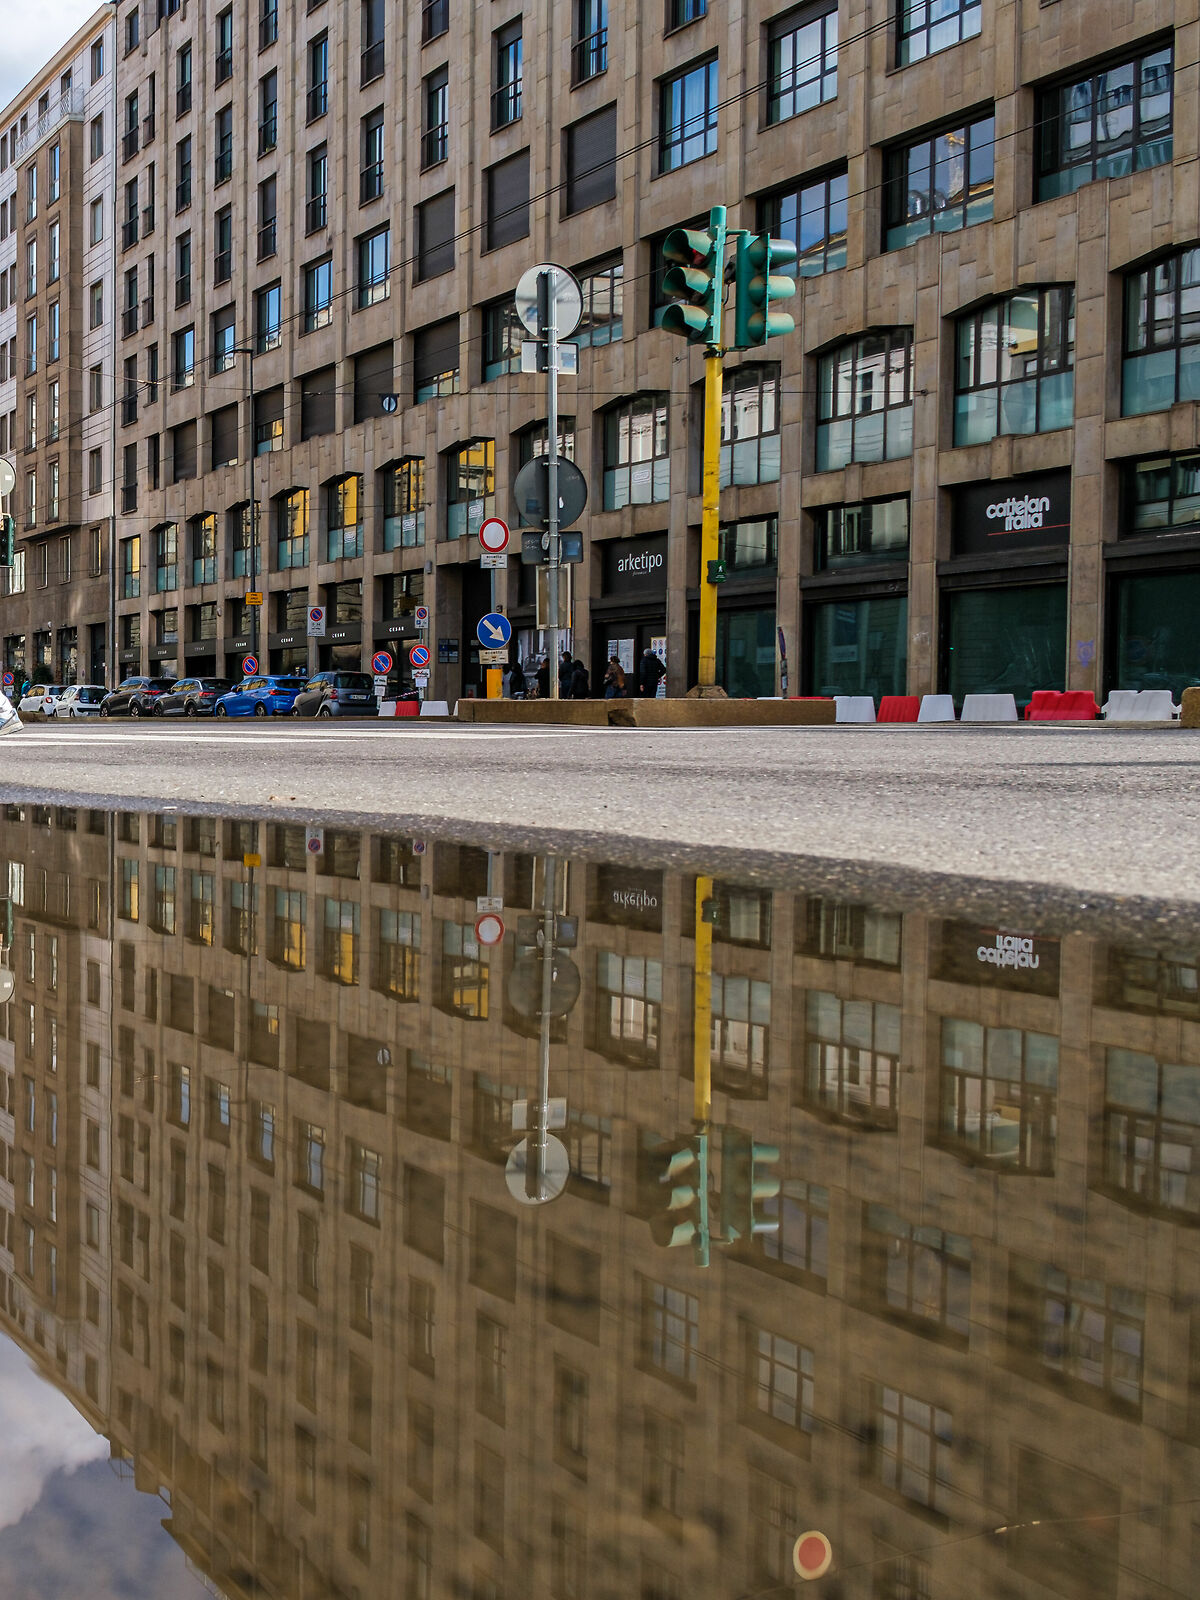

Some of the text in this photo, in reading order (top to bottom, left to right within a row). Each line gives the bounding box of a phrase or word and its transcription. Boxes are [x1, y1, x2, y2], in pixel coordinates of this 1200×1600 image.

[986, 494, 1050, 519] cattelan
[1005, 512, 1043, 531] italia
[618, 551, 663, 573] arketipo
